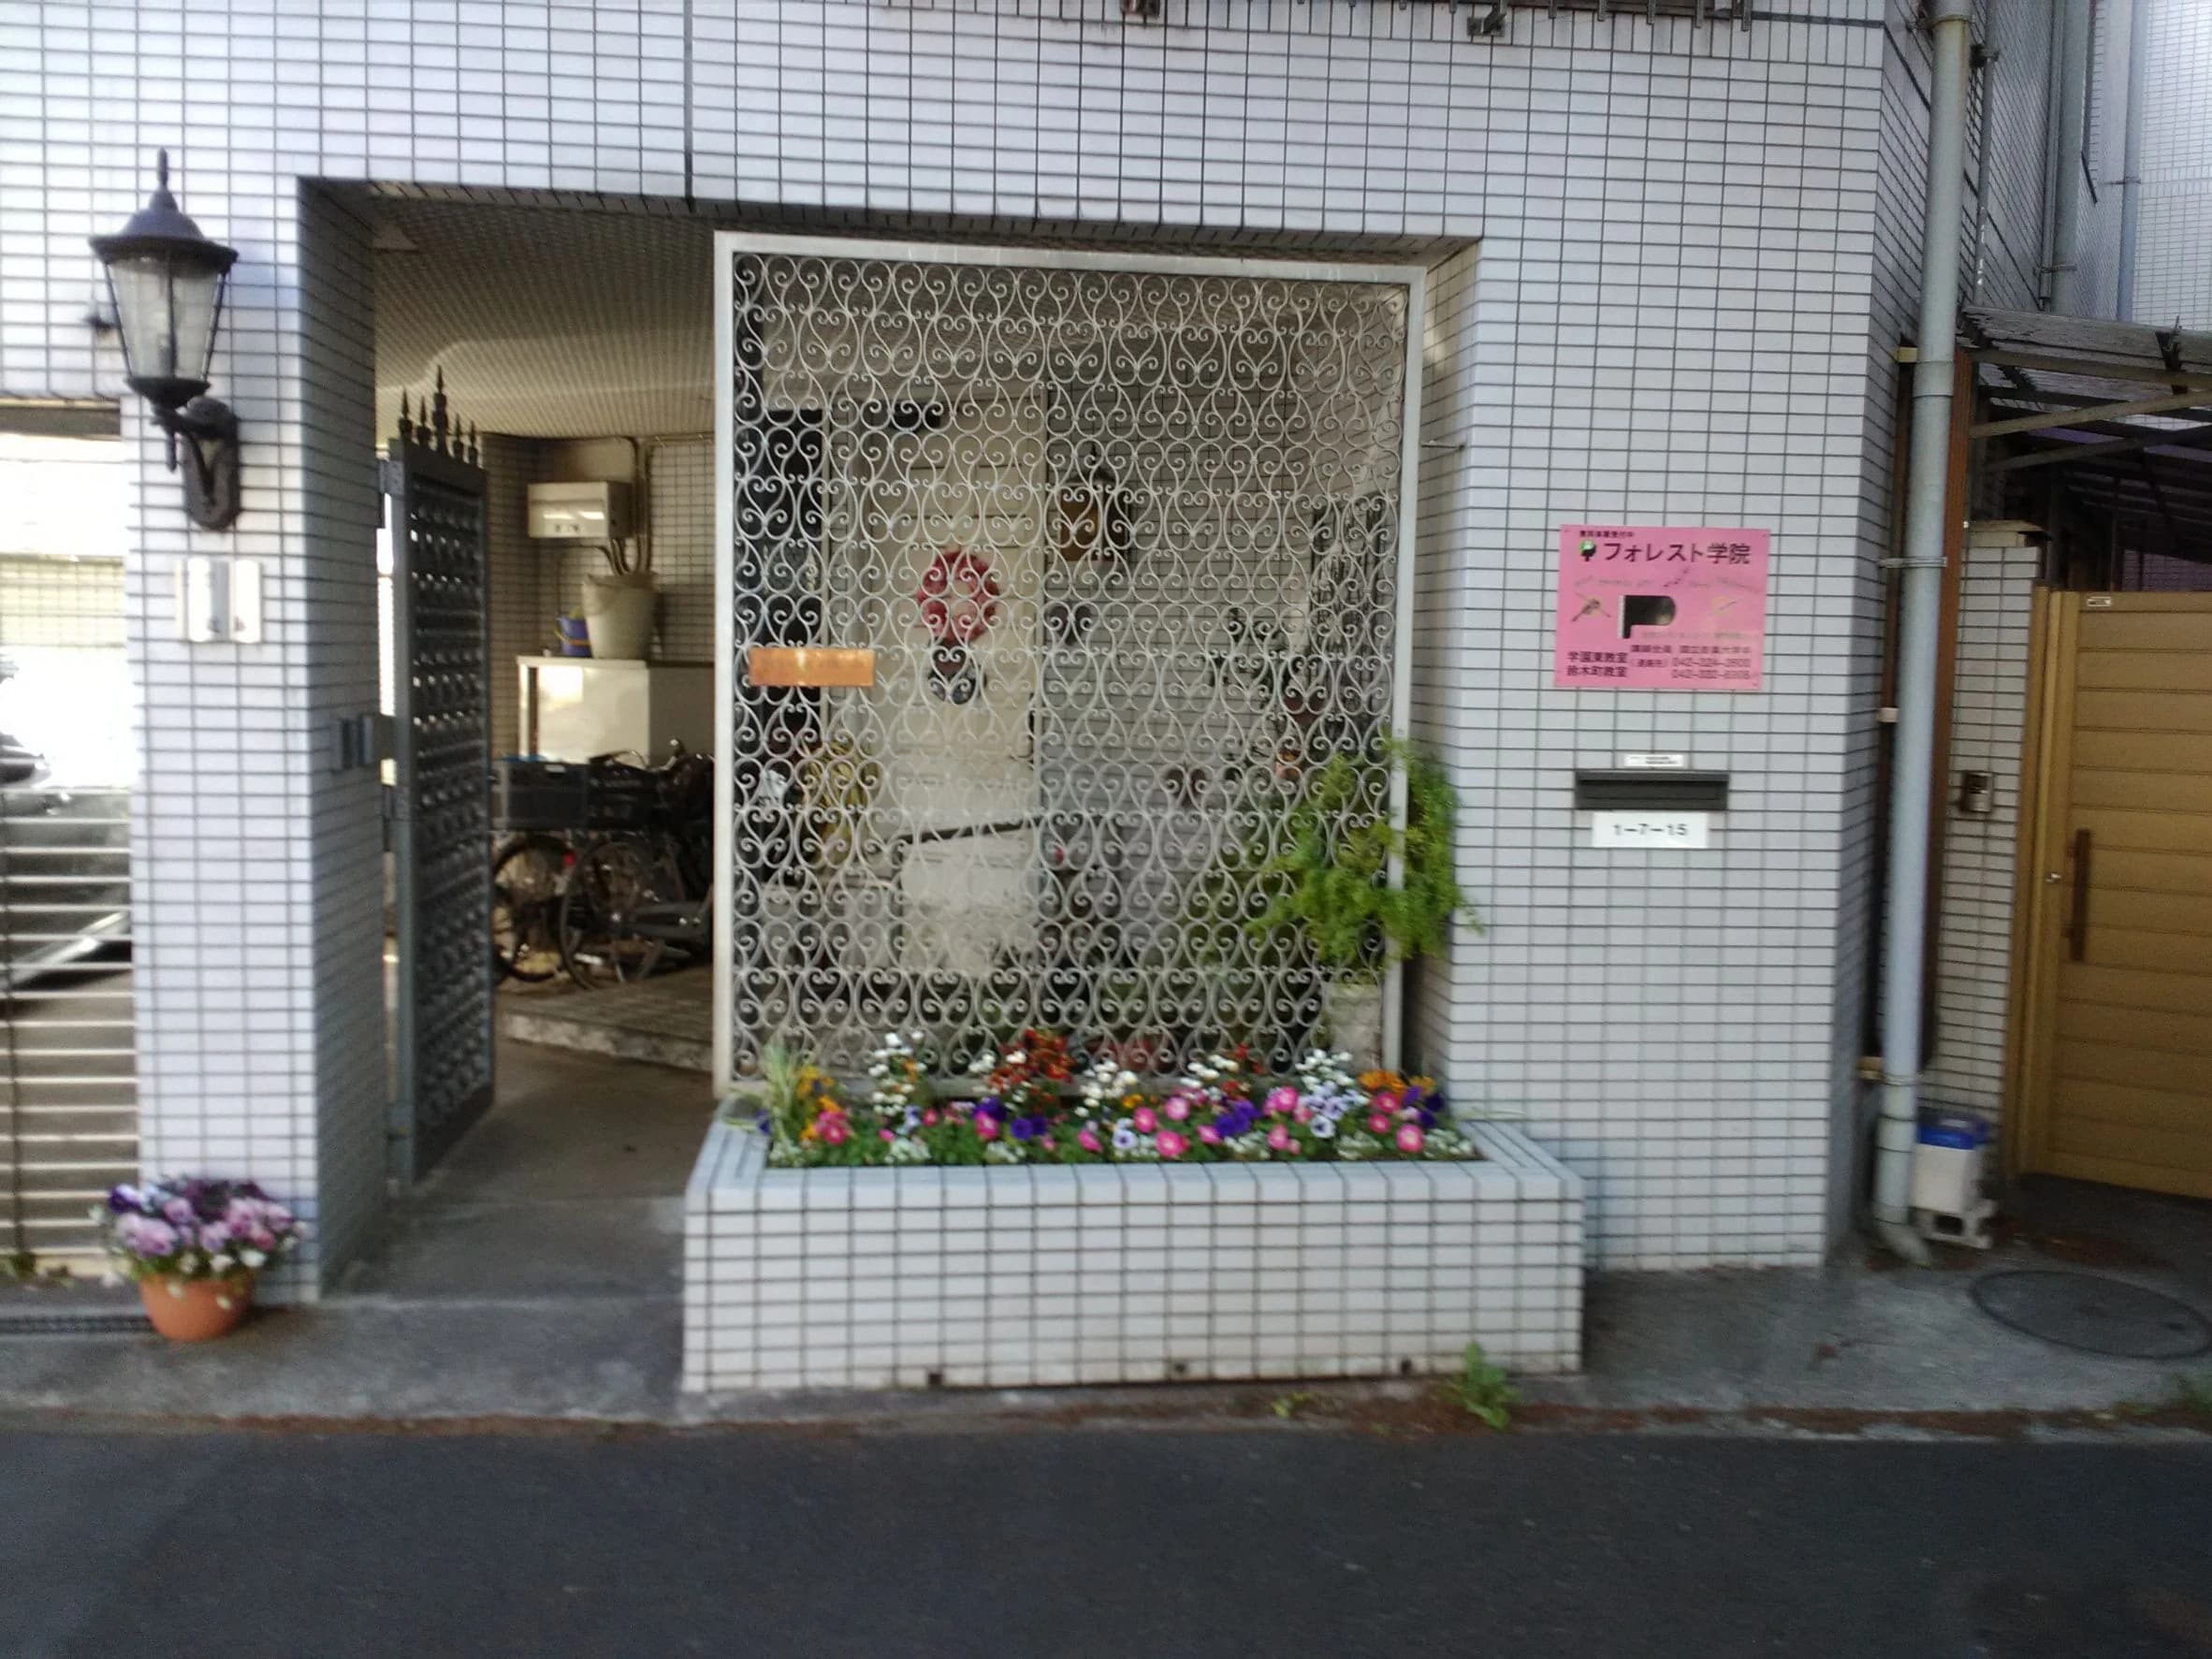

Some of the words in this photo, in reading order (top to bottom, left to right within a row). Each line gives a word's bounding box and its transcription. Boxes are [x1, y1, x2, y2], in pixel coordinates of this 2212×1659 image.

[1604, 542, 1752, 565] フォレスト学院
[1612, 822, 1689, 837] 1-7-15
